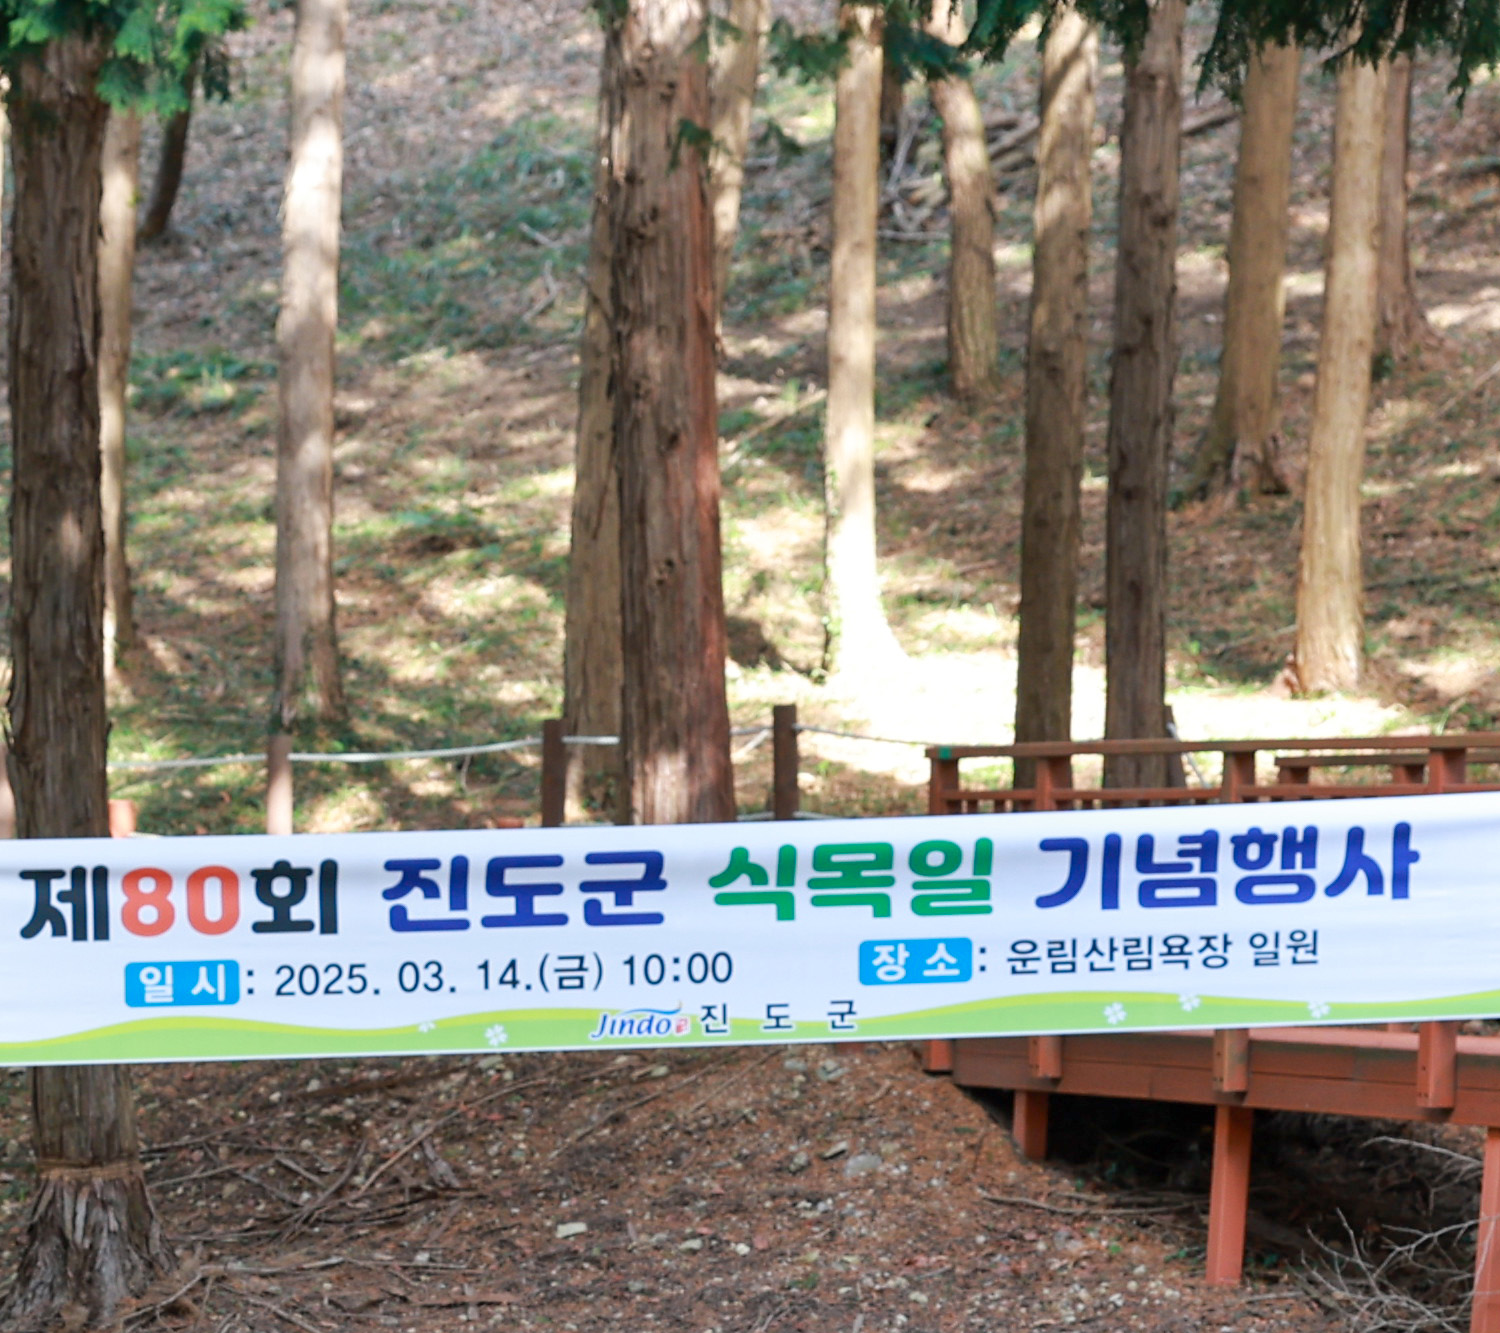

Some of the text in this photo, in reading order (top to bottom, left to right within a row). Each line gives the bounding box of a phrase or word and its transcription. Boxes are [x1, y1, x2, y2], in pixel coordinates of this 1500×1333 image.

[18, 821, 1420, 942] 제80회 진도군 식목일 기념행사
[275, 963, 380, 997] 2025.
[398, 960, 456, 993] 03.
[477, 952, 603, 993] 14.(금)
[623, 951, 733, 986] 10:00
[1006, 931, 1233, 976] 운림산림욕장
[1248, 929, 1319, 967] 일원
[590, 1013, 672, 1038] Jindo
